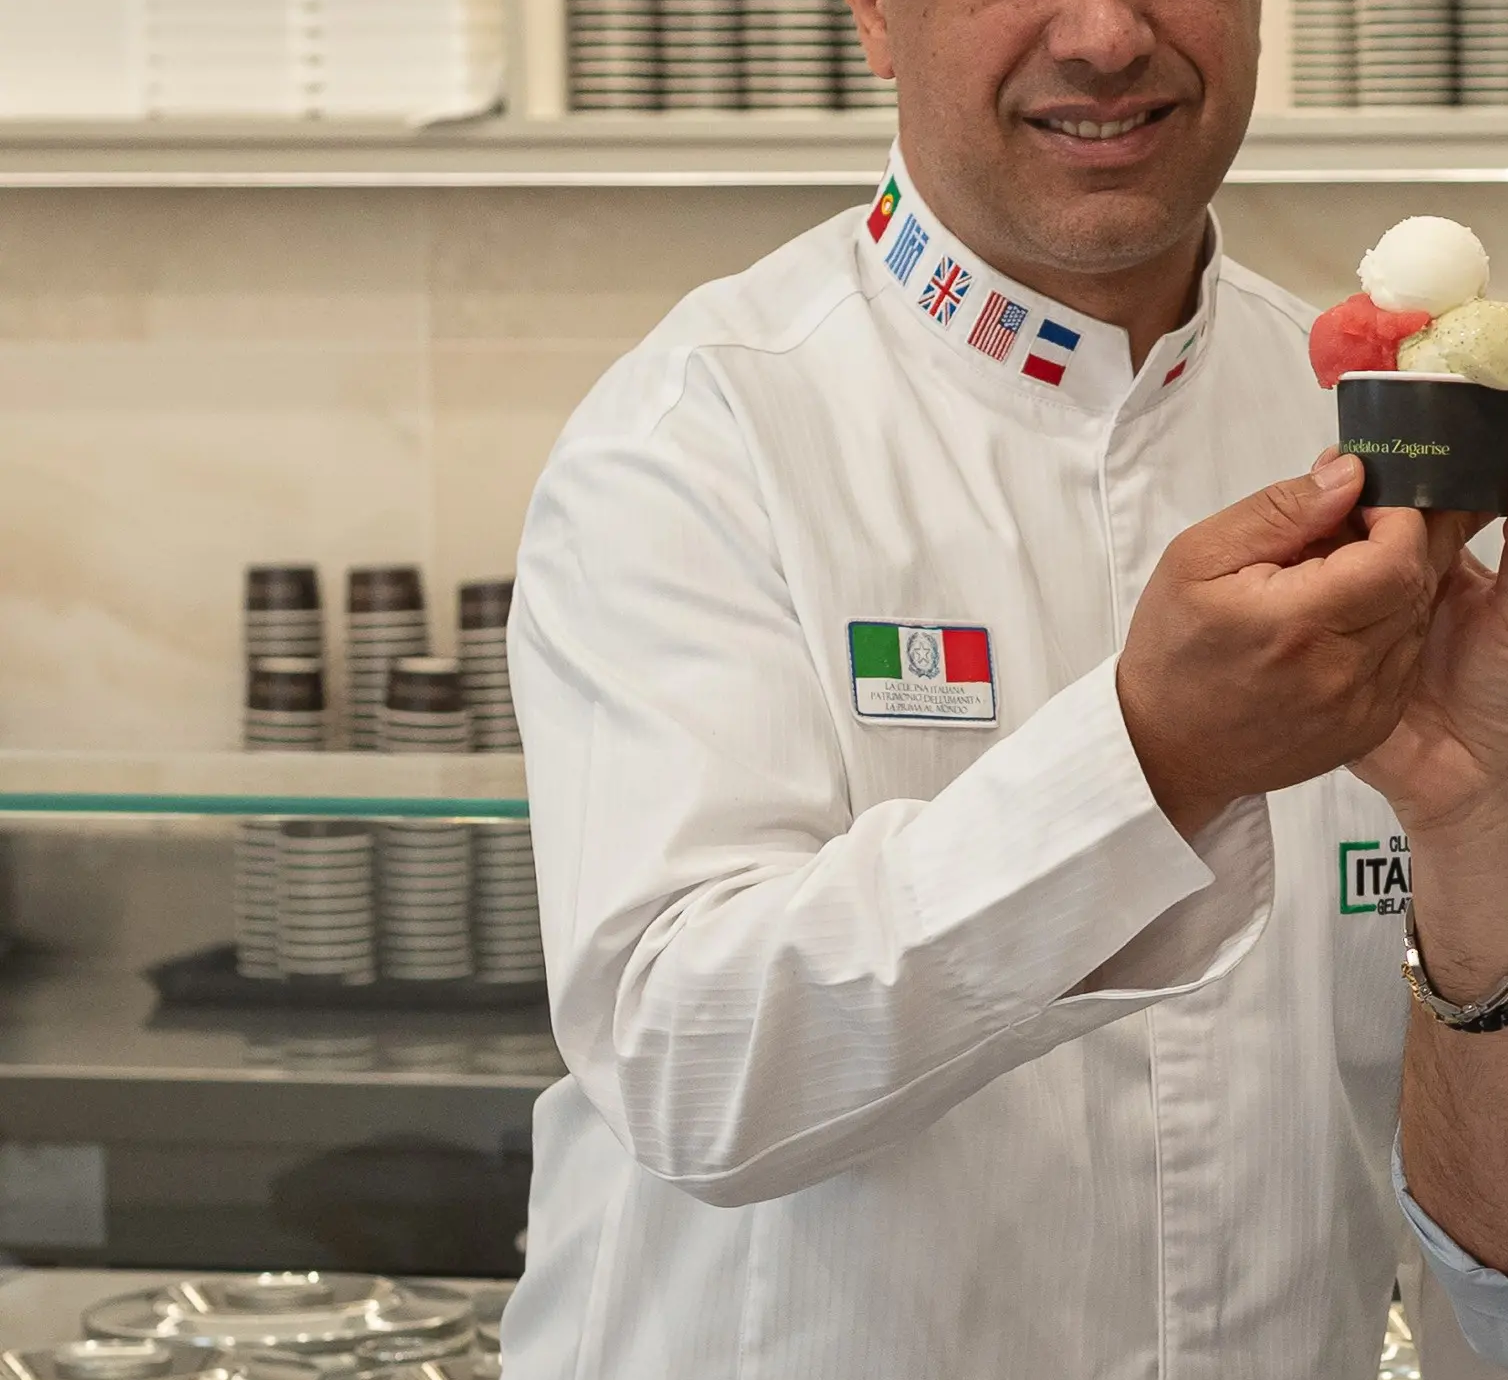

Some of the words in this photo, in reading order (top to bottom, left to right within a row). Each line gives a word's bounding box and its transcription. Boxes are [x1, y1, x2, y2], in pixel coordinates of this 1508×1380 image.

[1381, 442, 1390, 454] a
[1391, 439, 1451, 458] Zagarise
[885, 682, 896, 691] LA
[885, 703, 896, 712] LA
[935, 705, 969, 715] MONDO
